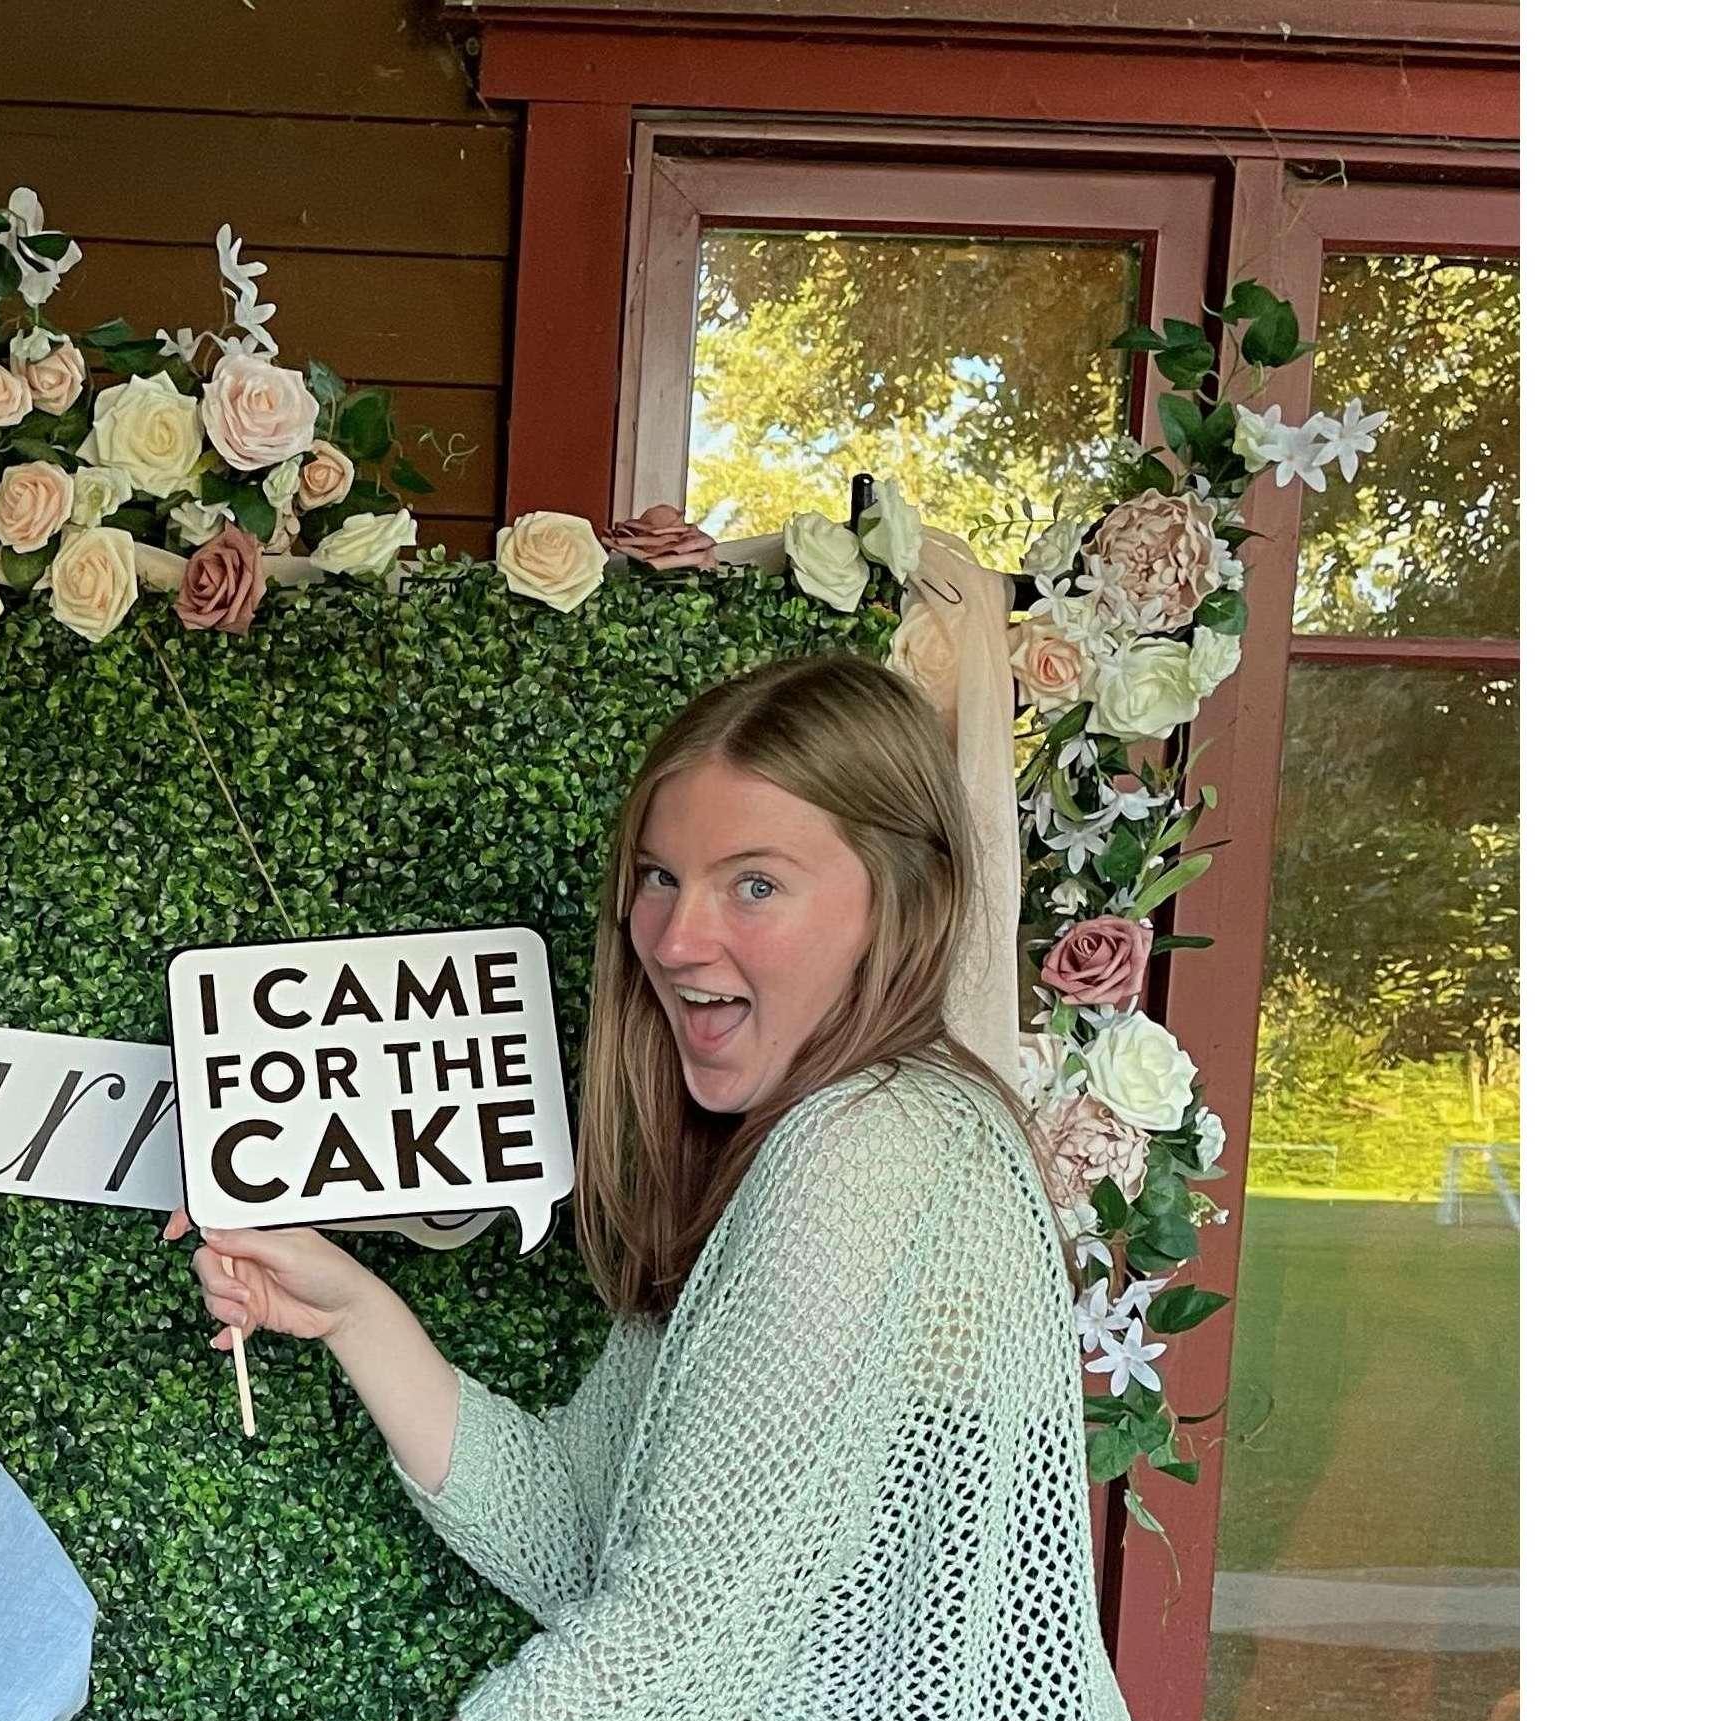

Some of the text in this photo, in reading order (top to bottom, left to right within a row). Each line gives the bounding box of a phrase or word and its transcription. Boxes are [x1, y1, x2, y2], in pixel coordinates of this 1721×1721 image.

[199, 951, 524, 1036] I CAME
[205, 1033, 533, 1110] FOR THE
[210, 1098, 544, 1204] CAKE
